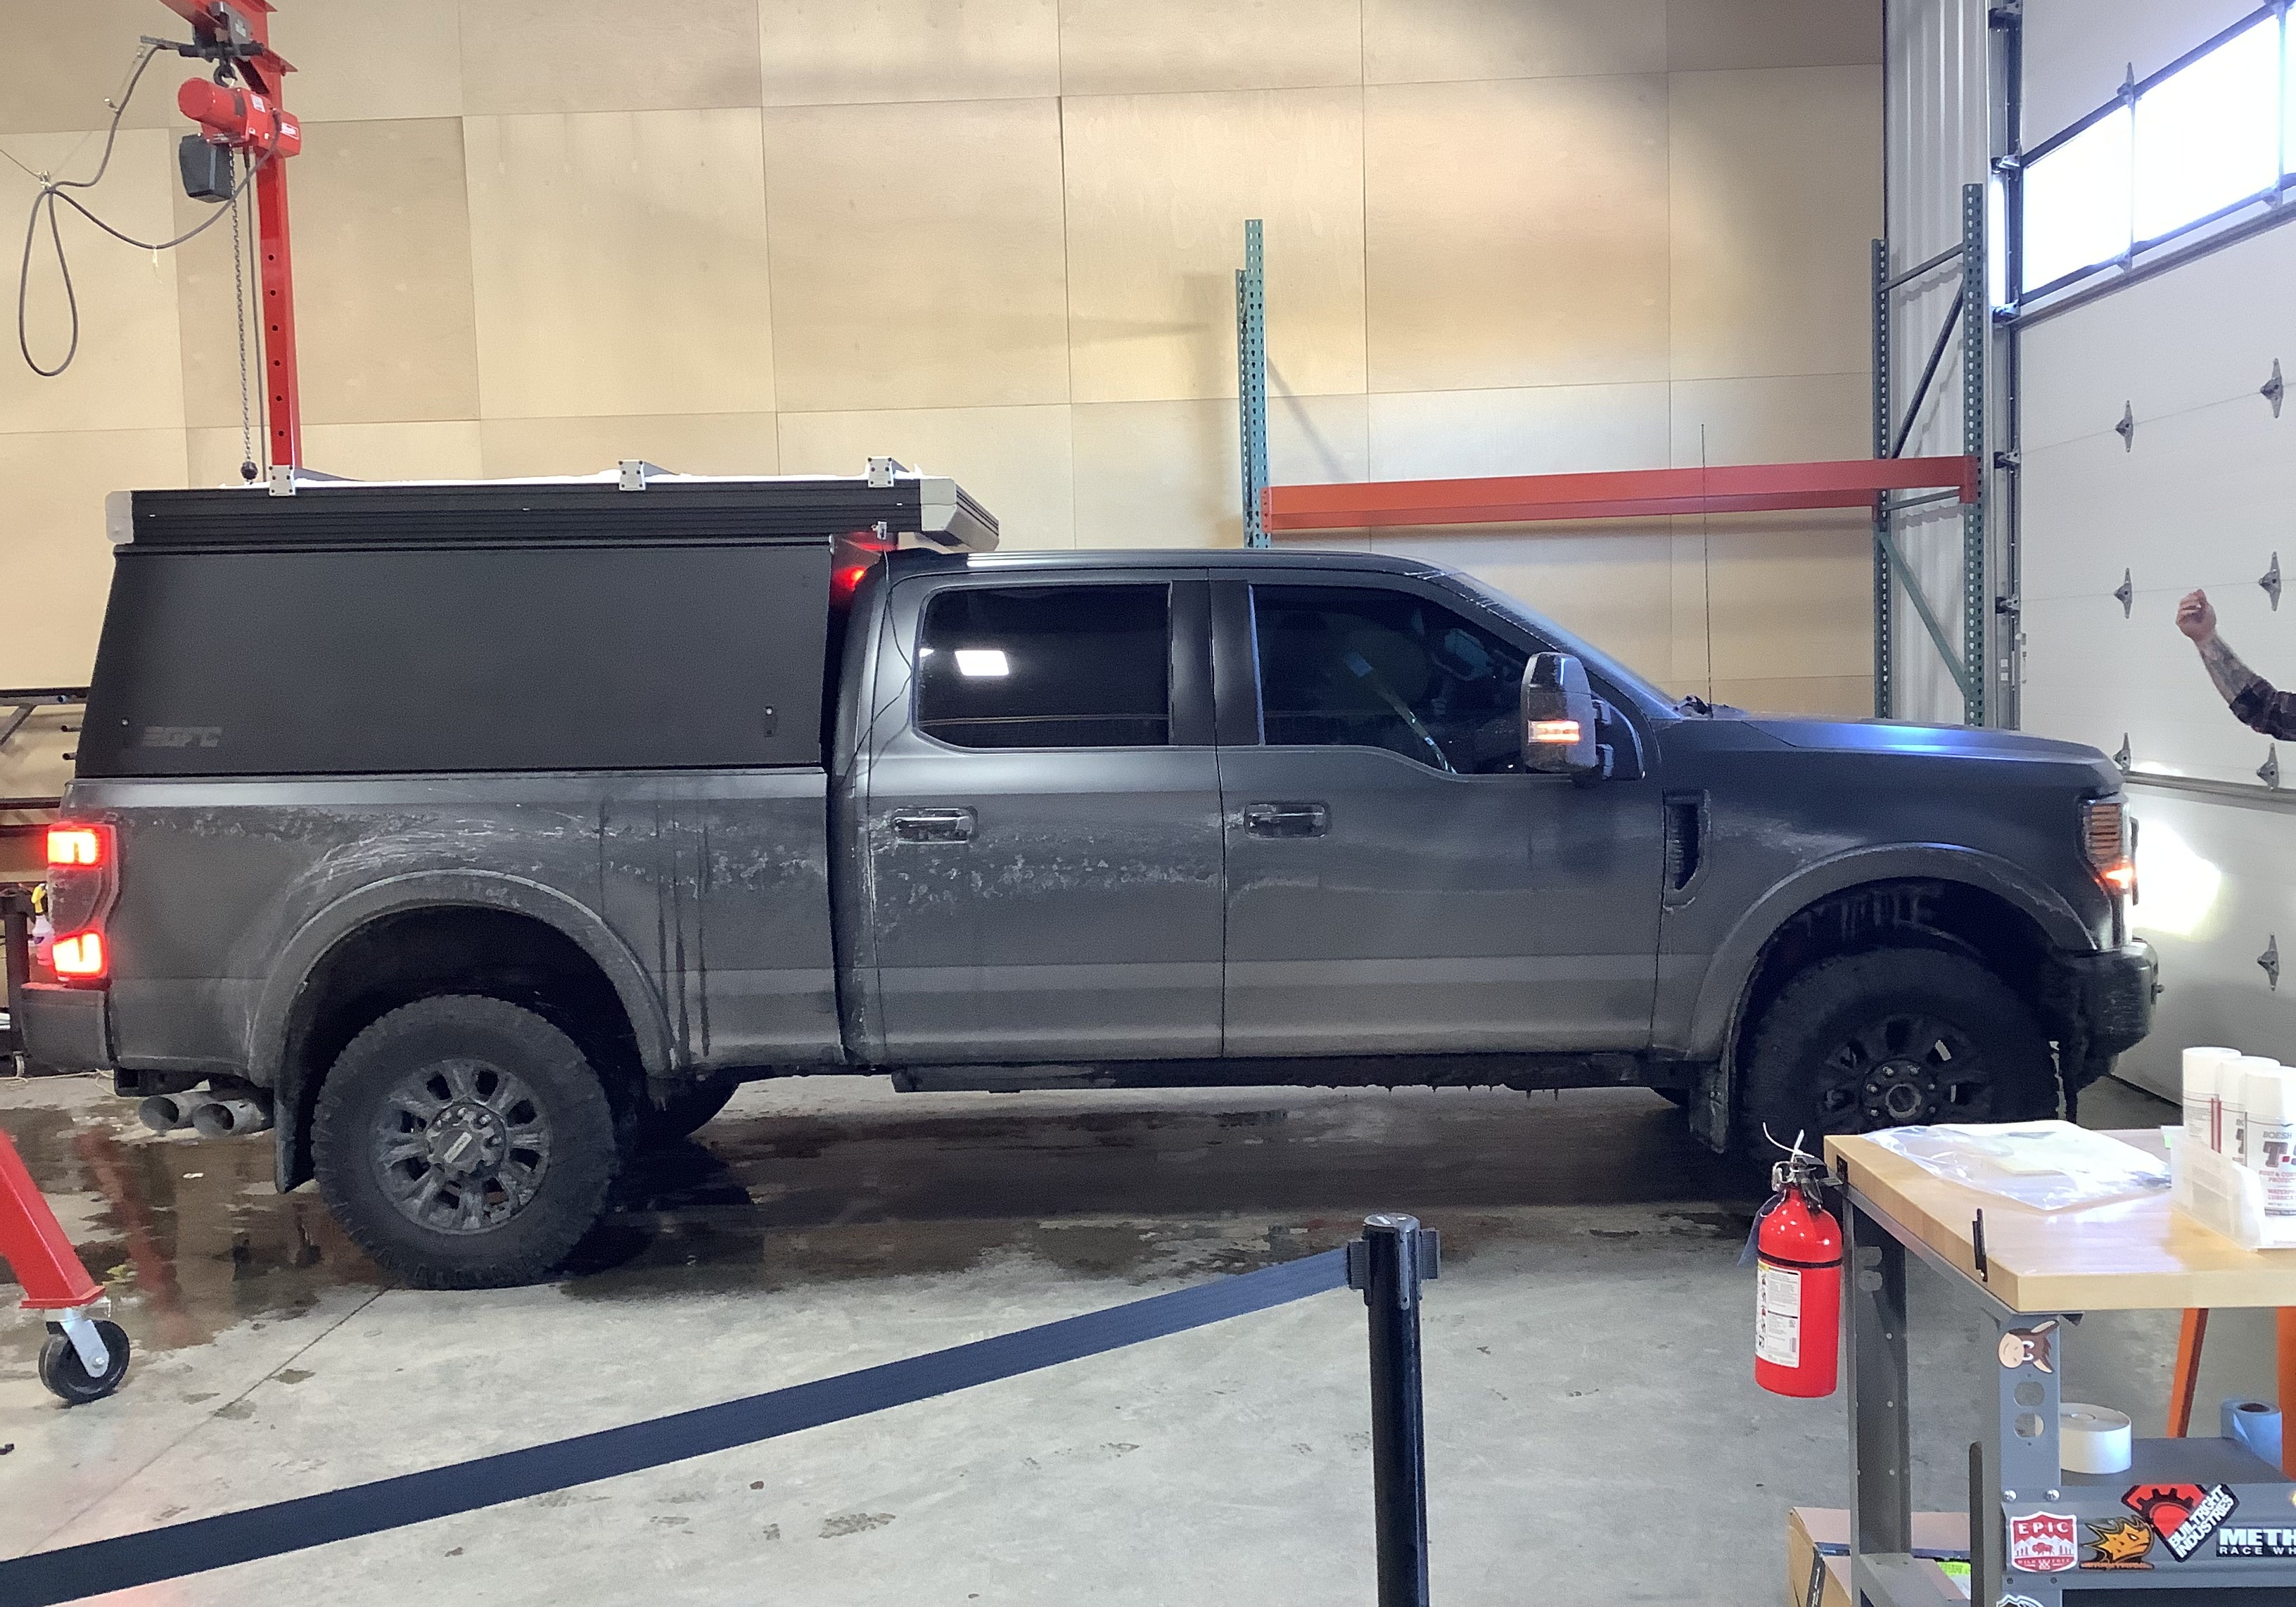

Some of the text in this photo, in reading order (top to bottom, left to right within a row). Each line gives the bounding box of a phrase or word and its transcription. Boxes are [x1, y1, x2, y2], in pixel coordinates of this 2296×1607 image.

[2018, 1522, 2068, 1534] EPIC
[2168, 1485, 2224, 1546] BUILTRIGHT
[2175, 1494, 2234, 1558] INDUSTRIES
